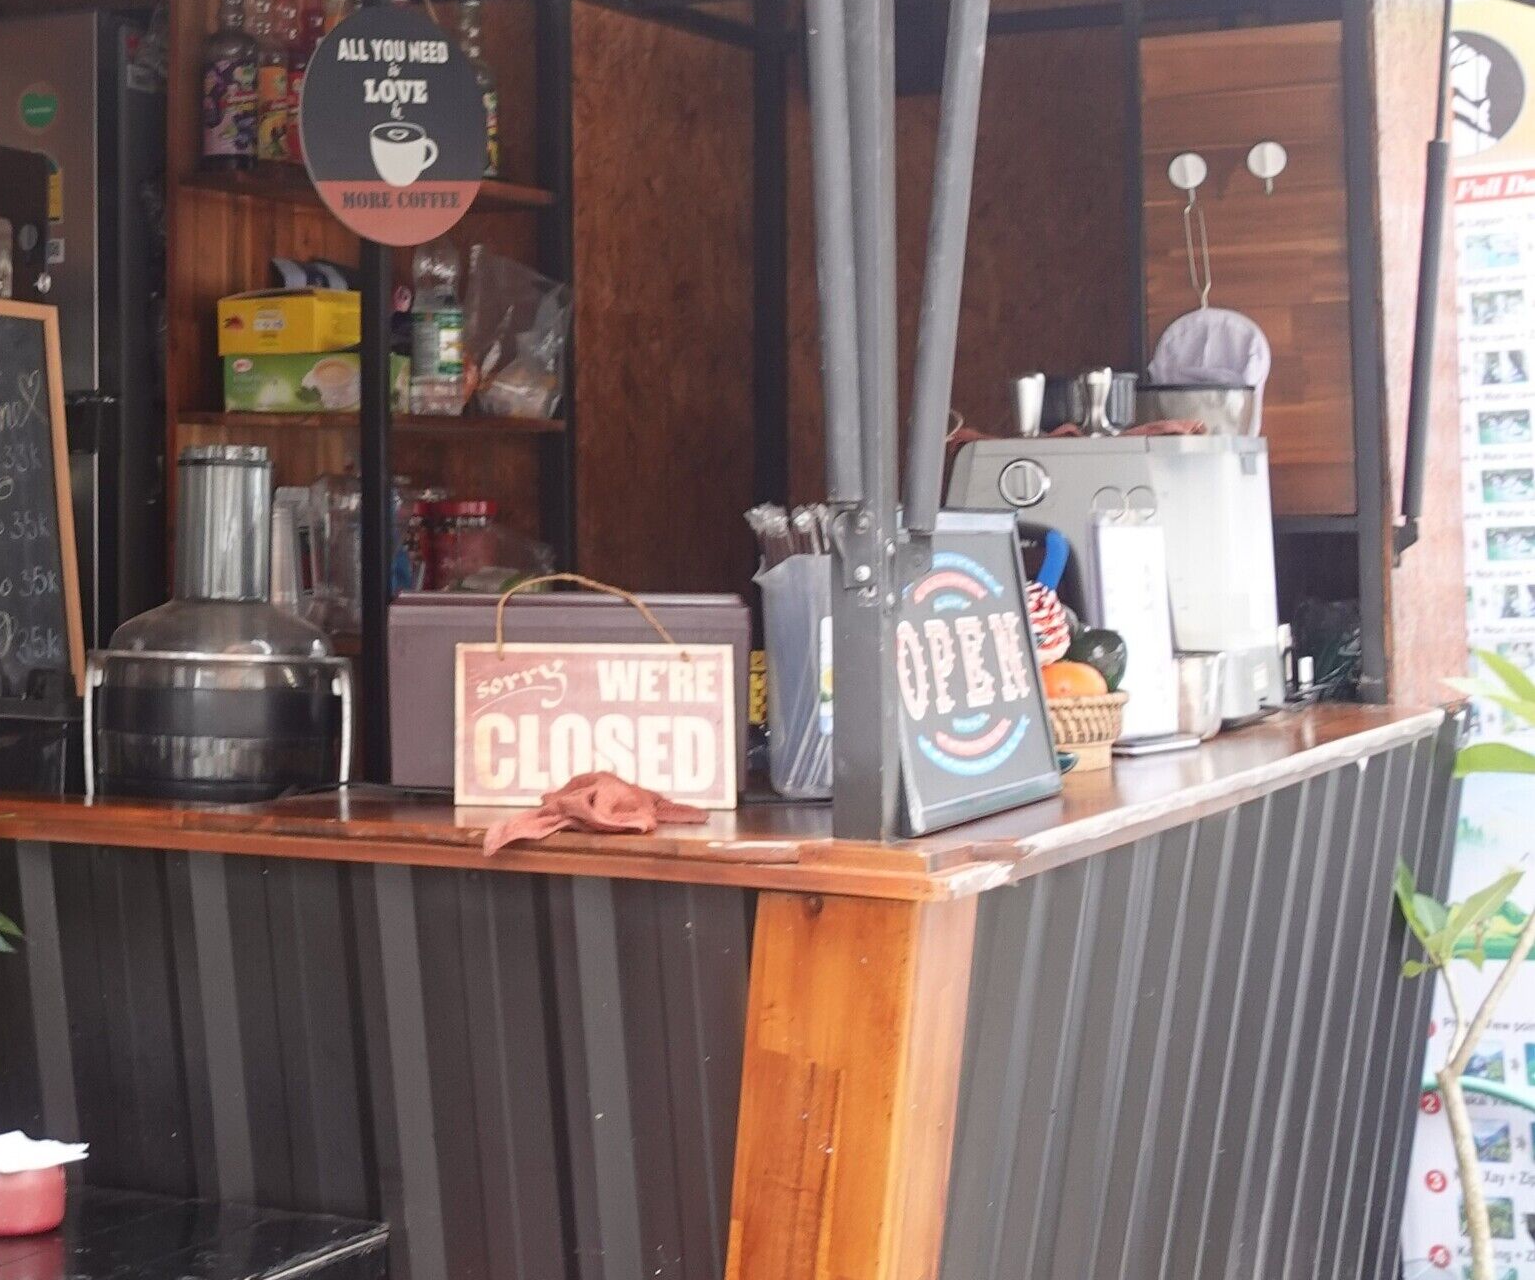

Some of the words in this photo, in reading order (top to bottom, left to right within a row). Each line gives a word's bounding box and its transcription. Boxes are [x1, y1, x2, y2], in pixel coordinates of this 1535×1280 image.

[337, 37, 369, 62] ALL
[370, 38, 407, 62] YOU
[409, 40, 449, 64] NEED
[363, 79, 428, 104] LOVE
[342, 192, 394, 209] MORE
[397, 192, 461, 209] COFFEE
[596, 659, 716, 703] WE'RE
[897, 611, 1030, 720] OPEN
[473, 712, 716, 794] CLOSED
